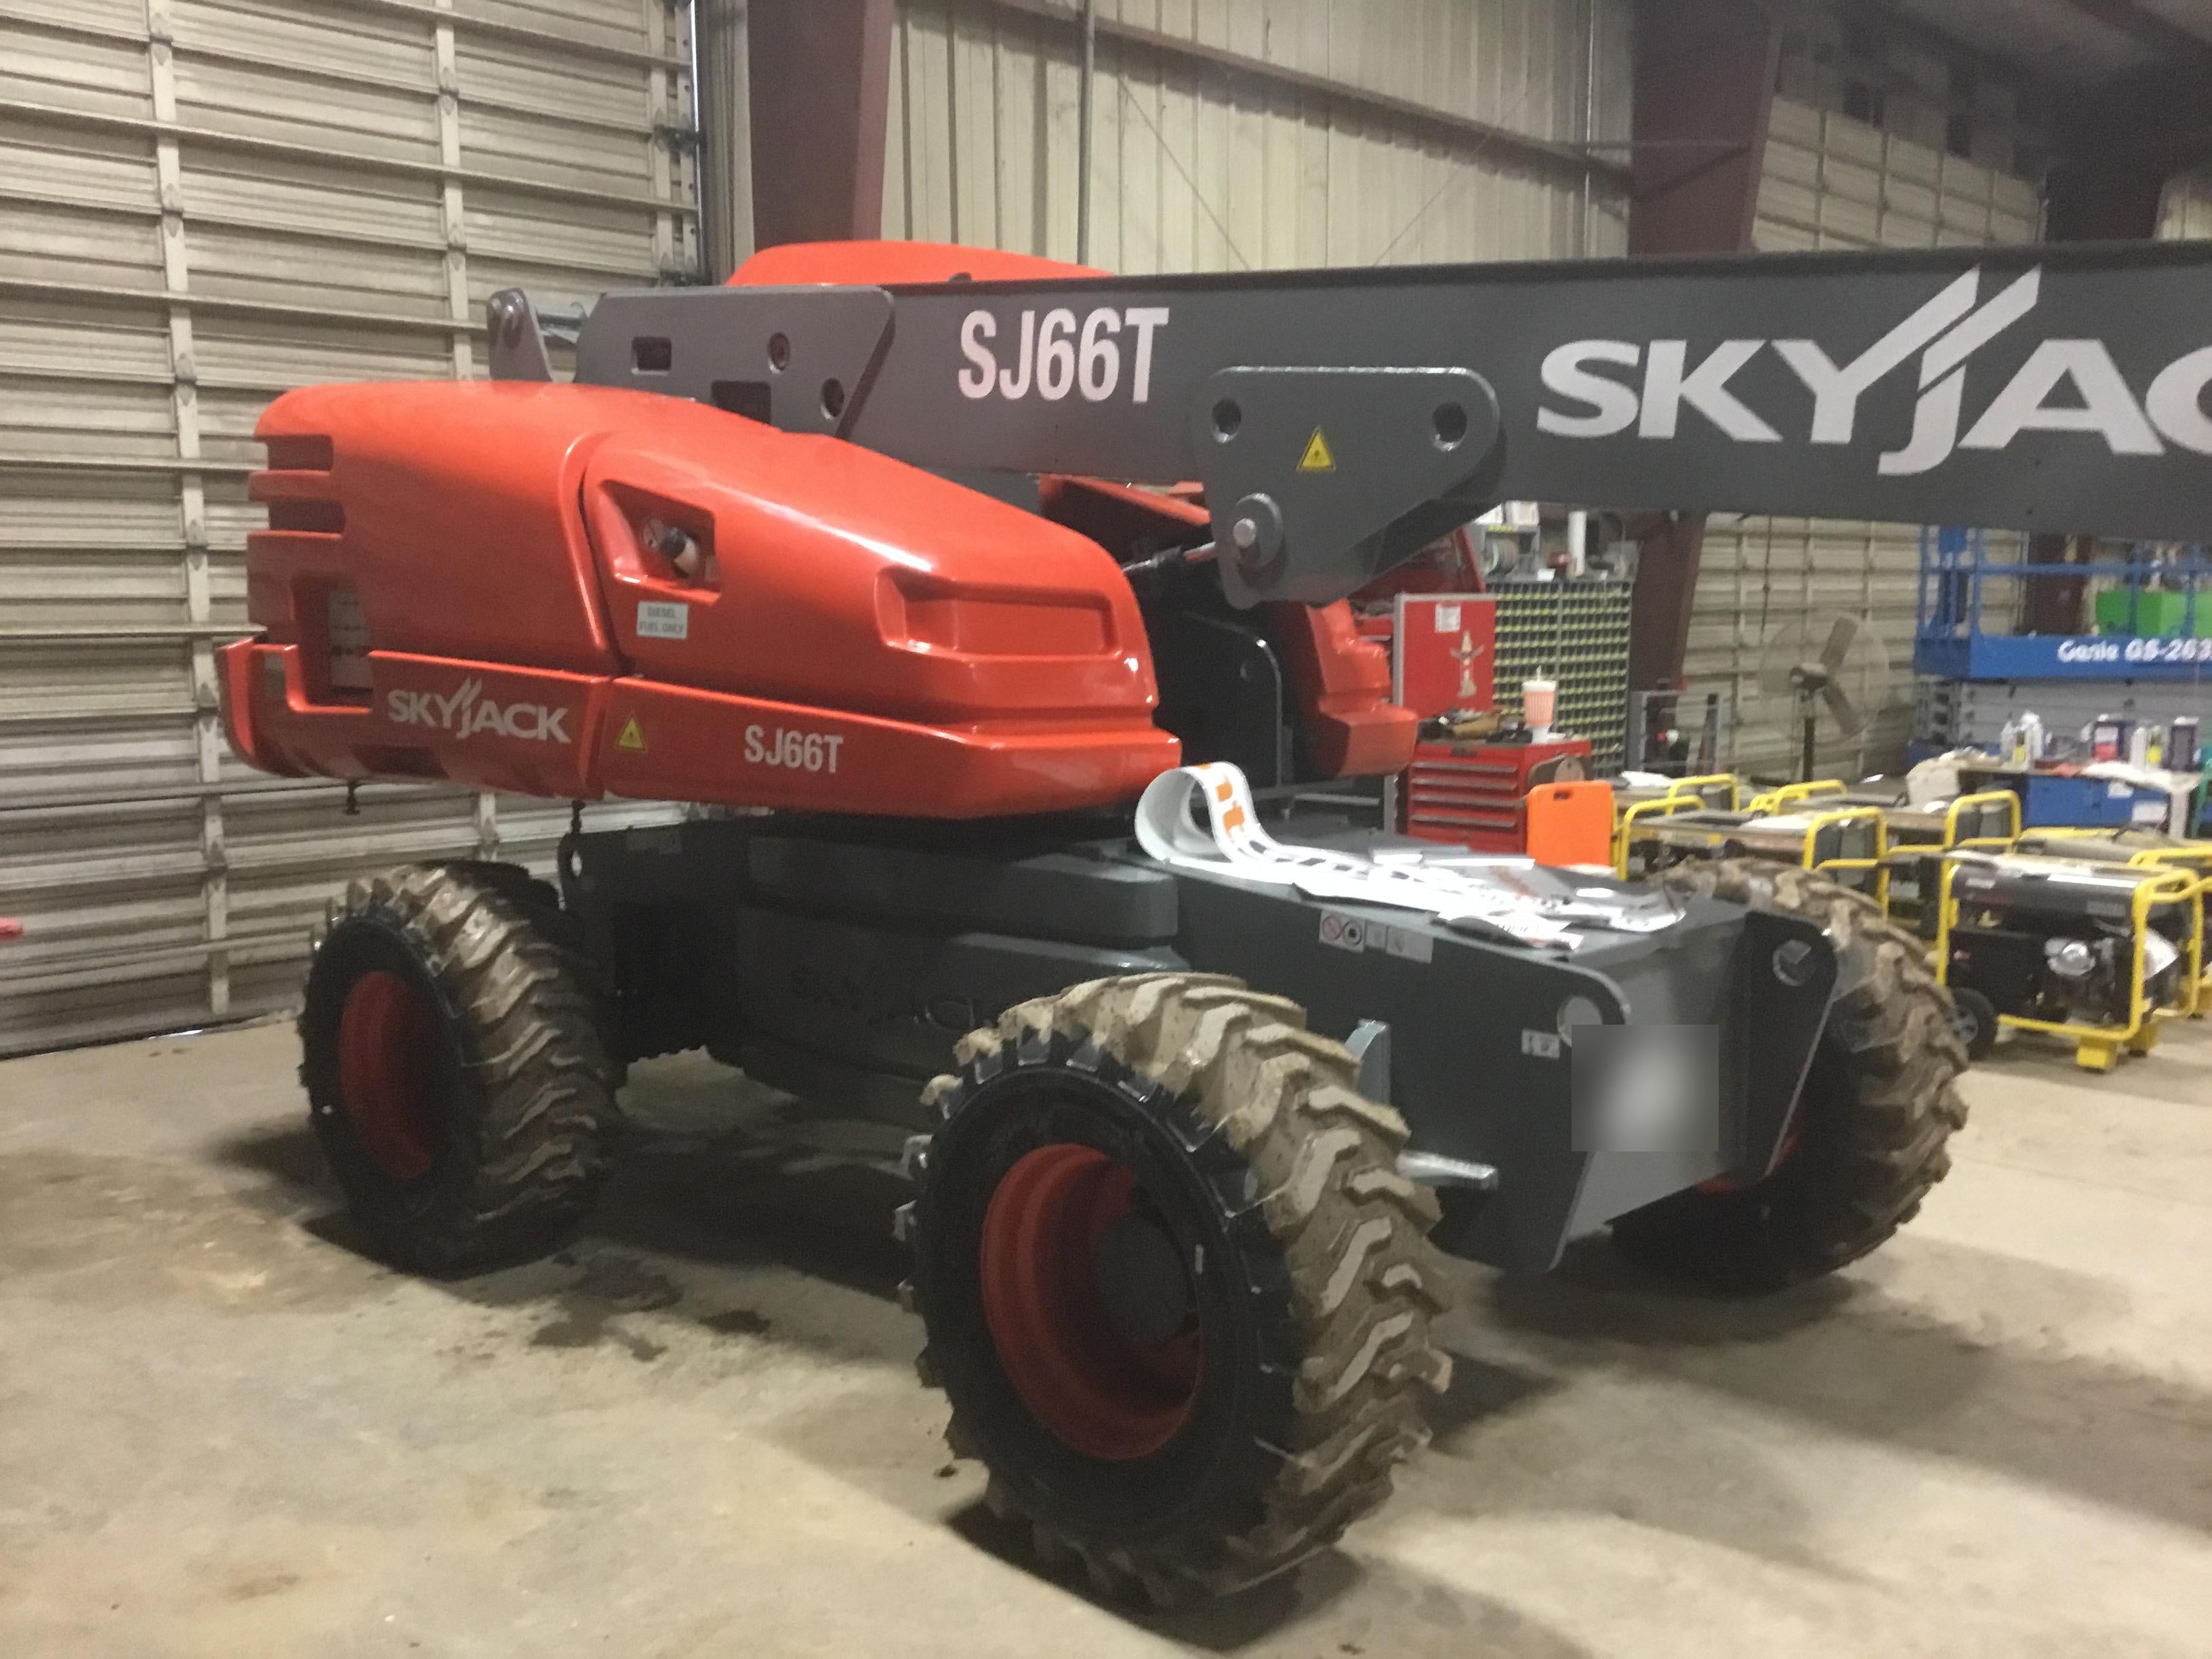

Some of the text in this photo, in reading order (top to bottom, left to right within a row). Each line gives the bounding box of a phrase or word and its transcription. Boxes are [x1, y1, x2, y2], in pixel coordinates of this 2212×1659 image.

[958, 307, 1170, 403] SJ66T
[387, 676, 572, 744] SKYJACK
[744, 724, 844, 773] SJ66T
